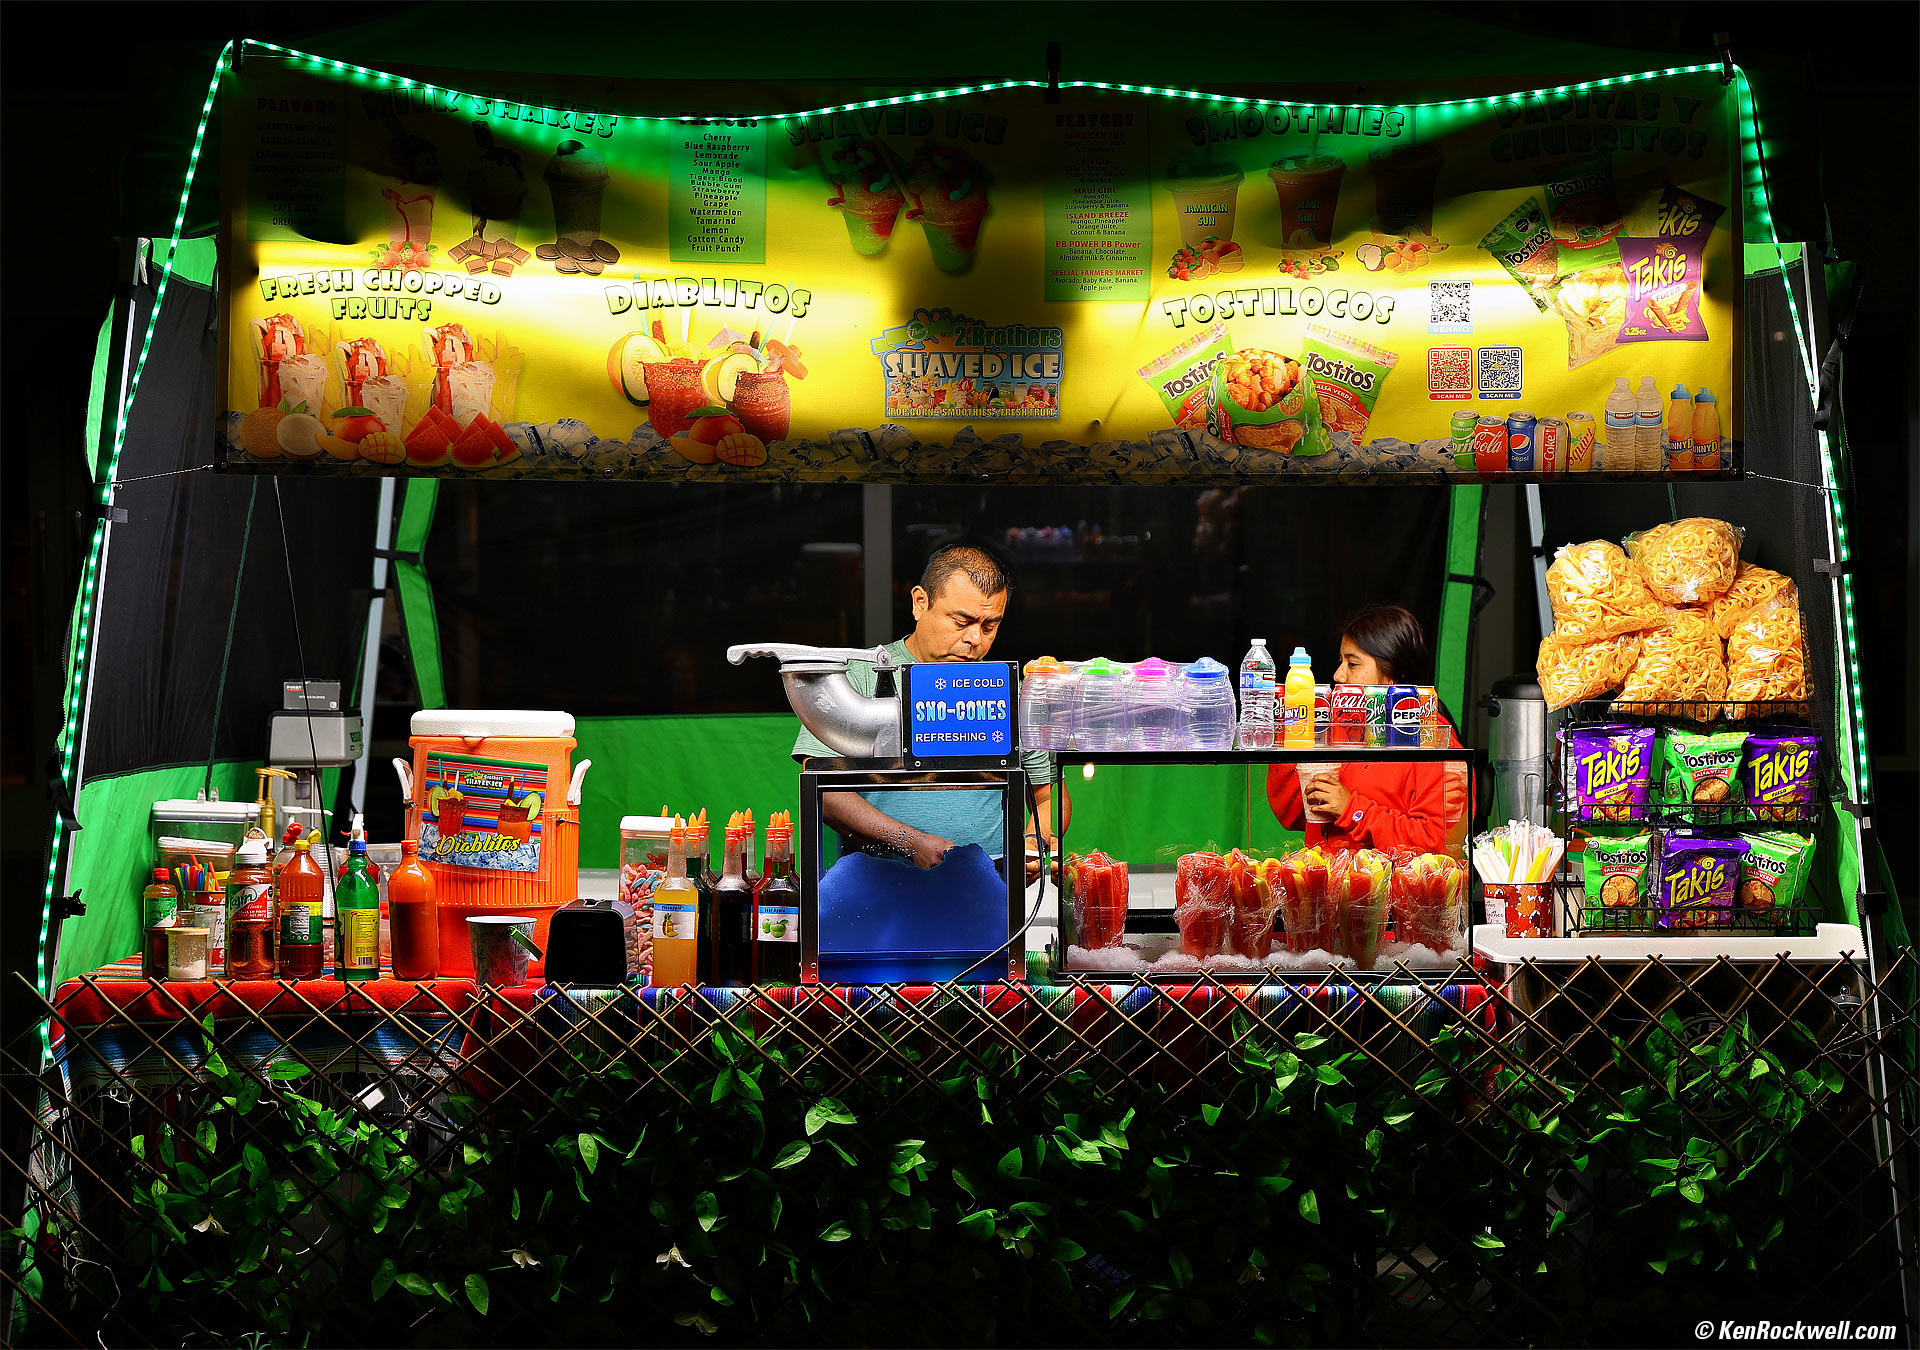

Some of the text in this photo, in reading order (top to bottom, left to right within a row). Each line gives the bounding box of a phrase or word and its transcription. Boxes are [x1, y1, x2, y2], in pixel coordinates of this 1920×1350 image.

[361, 87, 618, 138] MILK SHAKES
[1492, 89, 1702, 130] PAPITAS Y
[1055, 112, 1135, 128] FLAVORS
[785, 106, 1008, 147] SHAVED ICE
[1185, 104, 1405, 147] SMOOTHIES
[703, 133, 732, 143] Cherry
[684, 142, 750, 153] Blue Raspberry
[1490, 124, 1707, 163] CHURRITOS
[695, 151, 740, 160] Lemonade
[693, 159, 741, 170] Sour Apple
[702, 168, 732, 177] Mango
[690, 174, 744, 183] Tigers Blood
[691, 180, 721, 188] Bubble
[692, 186, 741, 196] Strawberry
[1074, 187, 1118, 195] MAUI GIRL
[695, 192, 738, 202] Pineapple
[1072, 198, 1103, 206] Pineapple
[1083, 193, 1111, 201] Avocado,
[703, 200, 729, 209] Grape
[1065, 203, 1099, 212] Strawberry
[1184, 202, 1230, 215] JAMAICAN
[1297, 199, 1321, 211] MAUI
[690, 207, 743, 217] Watermelon
[1098, 211, 1130, 219] BREEZE
[696, 216, 737, 226] Tamarind
[1094, 218, 1128, 226] Pineapple,
[1197, 215, 1217, 227] SUN
[1298, 212, 1318, 223] GIRL
[1659, 203, 1703, 237] akis
[702, 226, 730, 235] lemon
[1070, 229, 1096, 237] Coconut
[1103, 229, 1127, 237] Banana
[1077, 224, 1100, 232] Orange
[687, 235, 746, 246] Cotton Candy
[1055, 240, 1142, 249] PB POWER PB Power
[691, 243, 742, 253] Fruit Punch
[1069, 248, 1128, 256] Banana, Chocolate,
[1050, 269, 1145, 277] SPECIAL FARMERS MARKET
[1629, 253, 1687, 302] Takis
[1055, 277, 1140, 285] Avocado, Baby Kale, Banana,
[260, 269, 502, 305] FRESH CHOPPED
[1080, 284, 1098, 293] Apple
[604, 277, 812, 318] DIABLITOS
[331, 296, 432, 321] FRUITS
[1162, 286, 1395, 328] TOSTILOCOS
[953, 327, 1062, 348] 2 Brothers
[886, 352, 1060, 379] SHAVED ICE
[889, 408, 1057, 418] POP CORN SMOOTHIES FRESH FRUIT
[952, 678, 1005, 688] ICE COLD
[915, 699, 1007, 722] SNO-CONES
[1393, 711, 1420, 720] PEPS
[915, 732, 987, 743] REFRESHING
[1581, 748, 1641, 797] Takis
[1693, 769, 1729, 783] SALSA VERDE
[1747, 750, 1809, 798] Takis
[435, 833, 521, 856] Diablitos
[1602, 866, 1640, 875] SALSA VERDE
[1664, 861, 1725, 909] Takis
